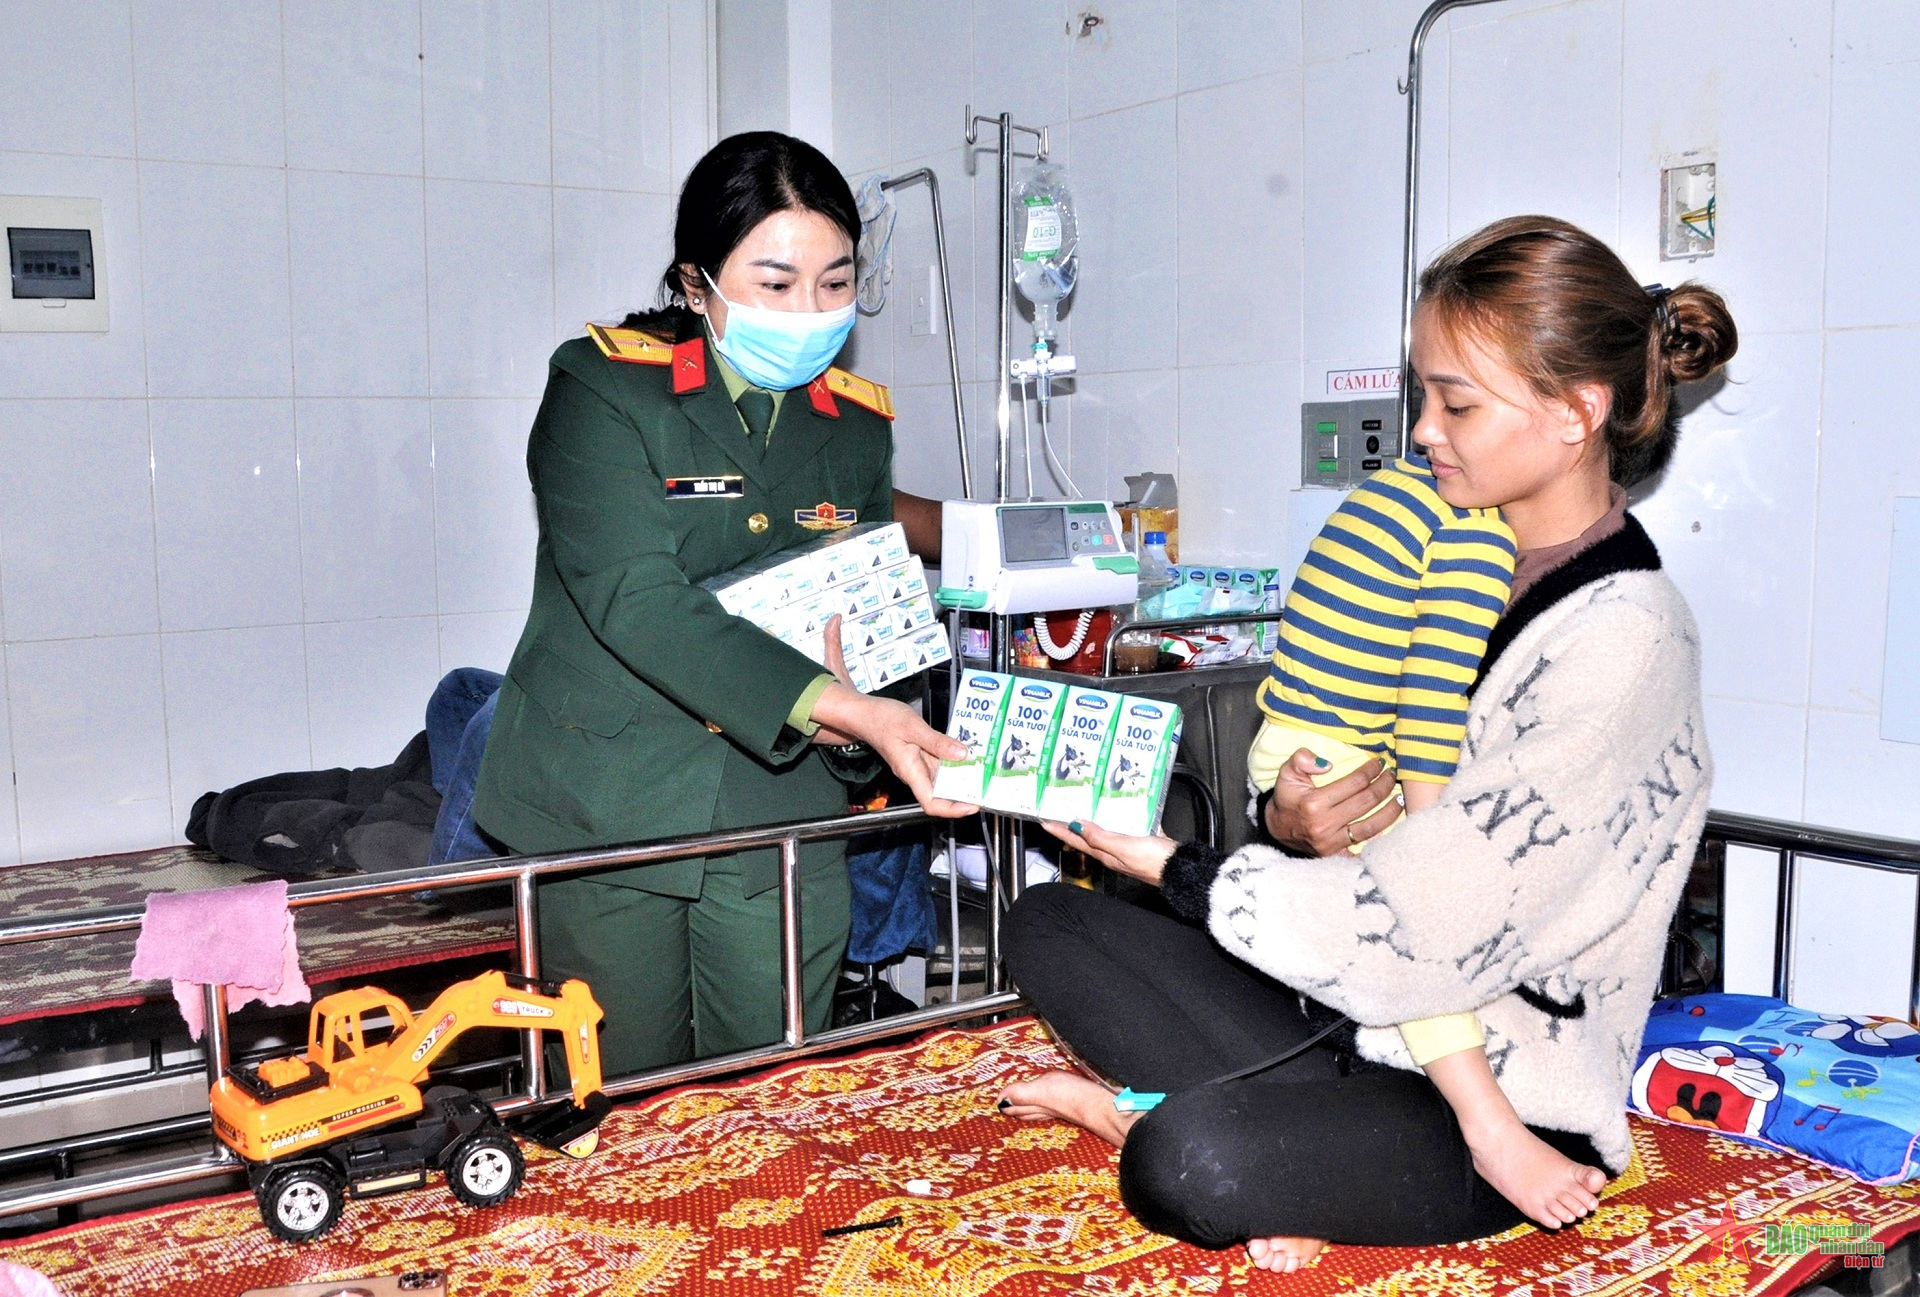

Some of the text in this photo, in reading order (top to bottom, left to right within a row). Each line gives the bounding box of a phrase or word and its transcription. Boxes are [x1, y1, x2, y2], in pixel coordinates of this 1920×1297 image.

[971, 679, 998, 689] VINAMILK
[1024, 689, 1051, 699] VINAMILK
[522, 1006, 544, 1014] TRUCK
